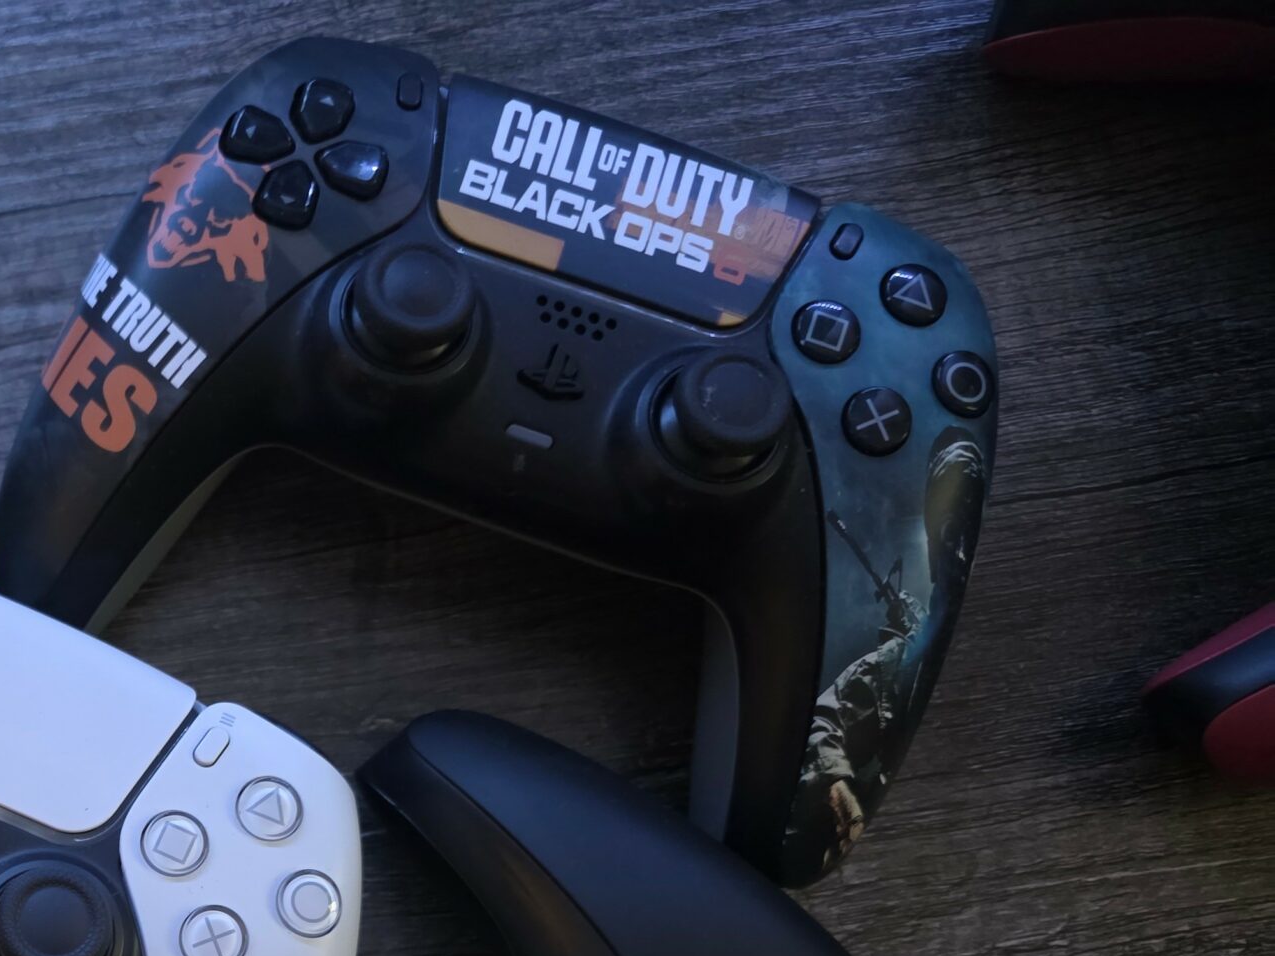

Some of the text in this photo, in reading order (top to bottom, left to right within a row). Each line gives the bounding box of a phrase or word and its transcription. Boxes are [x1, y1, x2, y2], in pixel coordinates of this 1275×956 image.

[459, 159, 615, 240] BLACK
[613, 211, 714, 274] OPS
[491, 99, 754, 237] CALL OF DUTY
[40, 315, 158, 453] IES
[81, 252, 208, 390] HE TRUTH
